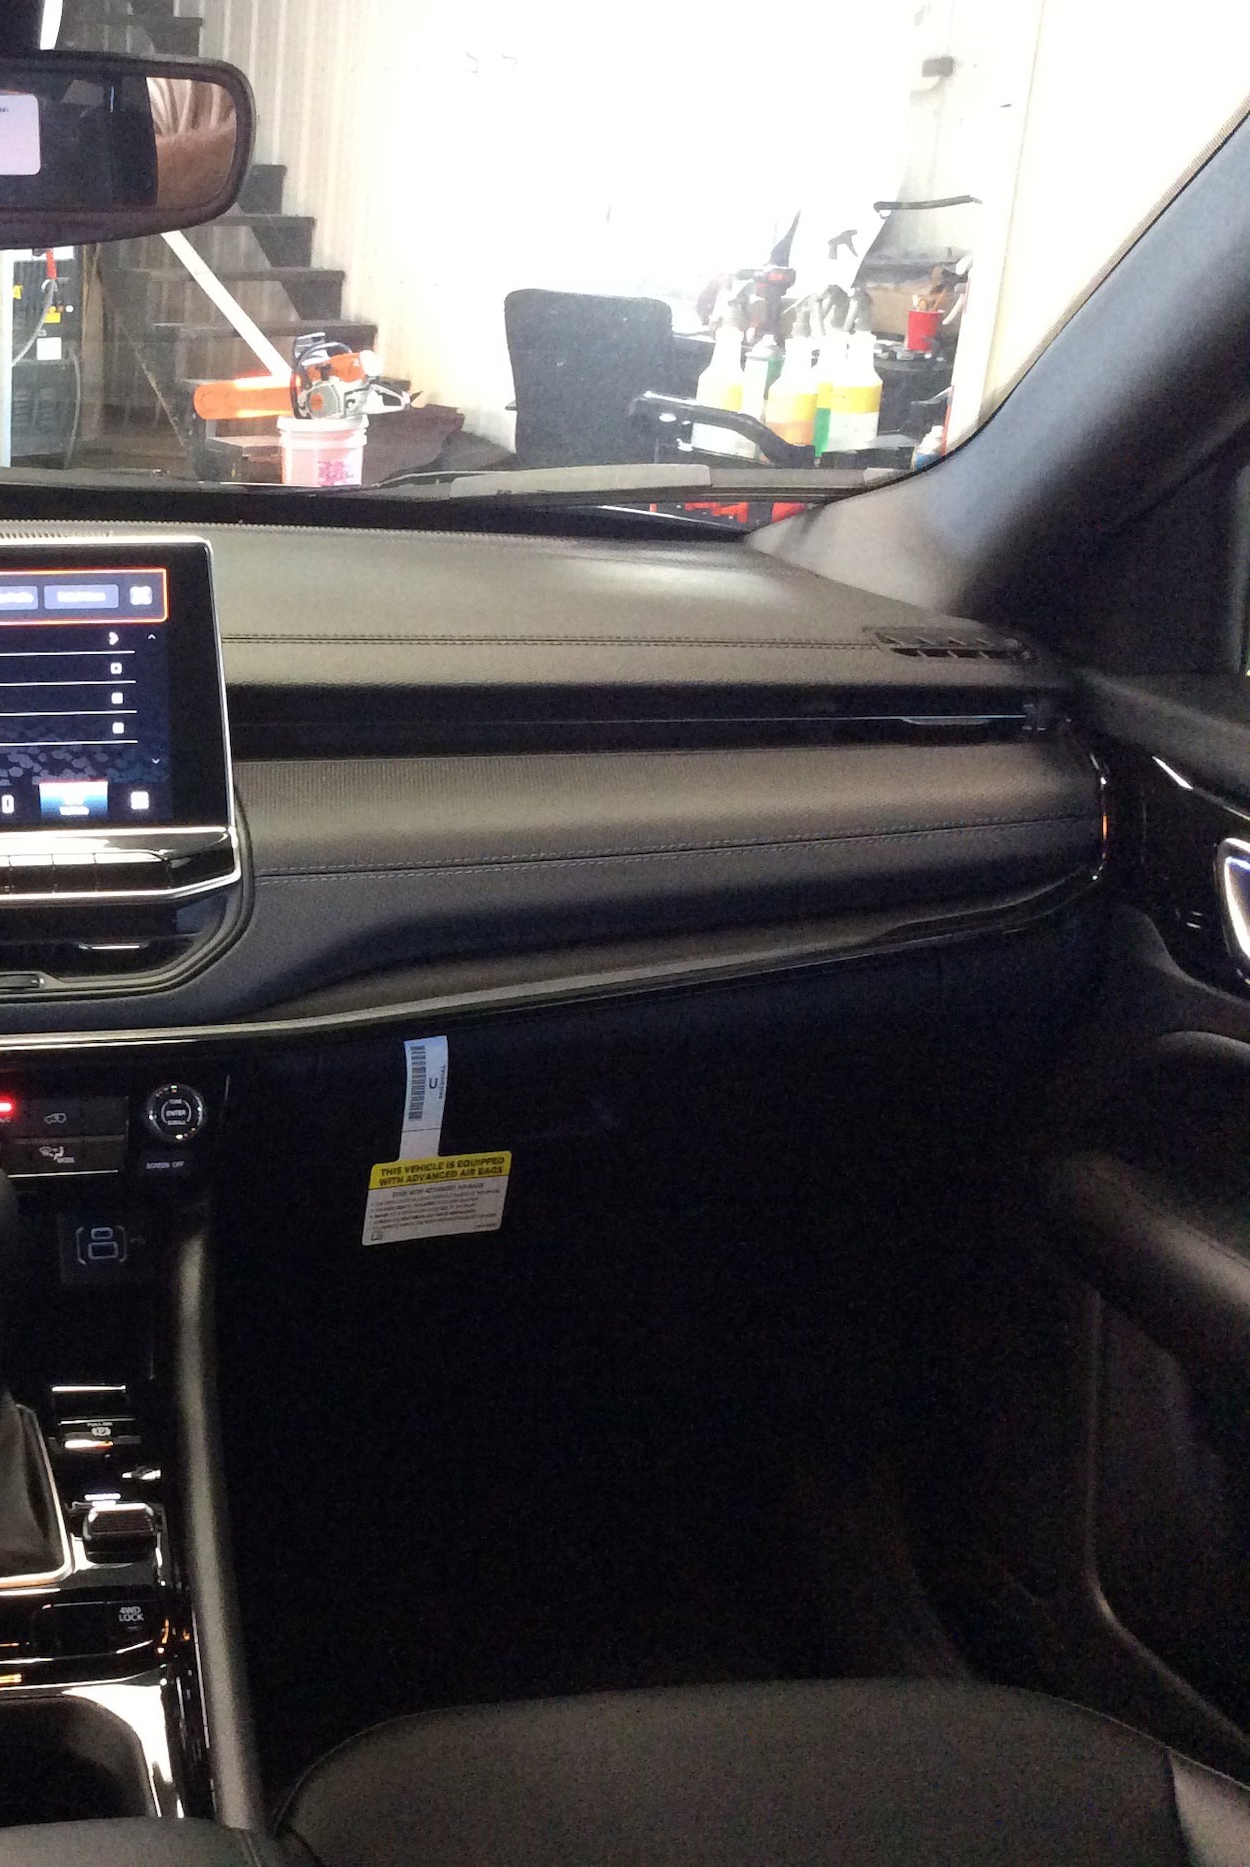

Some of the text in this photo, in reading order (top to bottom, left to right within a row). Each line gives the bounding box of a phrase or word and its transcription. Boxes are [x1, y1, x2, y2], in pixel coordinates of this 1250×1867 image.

[171, 1160, 185, 1168] OFF
[380, 1156, 505, 1176] THIS VEHICLE IS EQUIPPED
[379, 1166, 503, 1187] WITH ADVANCED AIR BAGS
[119, 1605, 142, 1614] 4WD
[117, 1613, 145, 1623] LOCK
